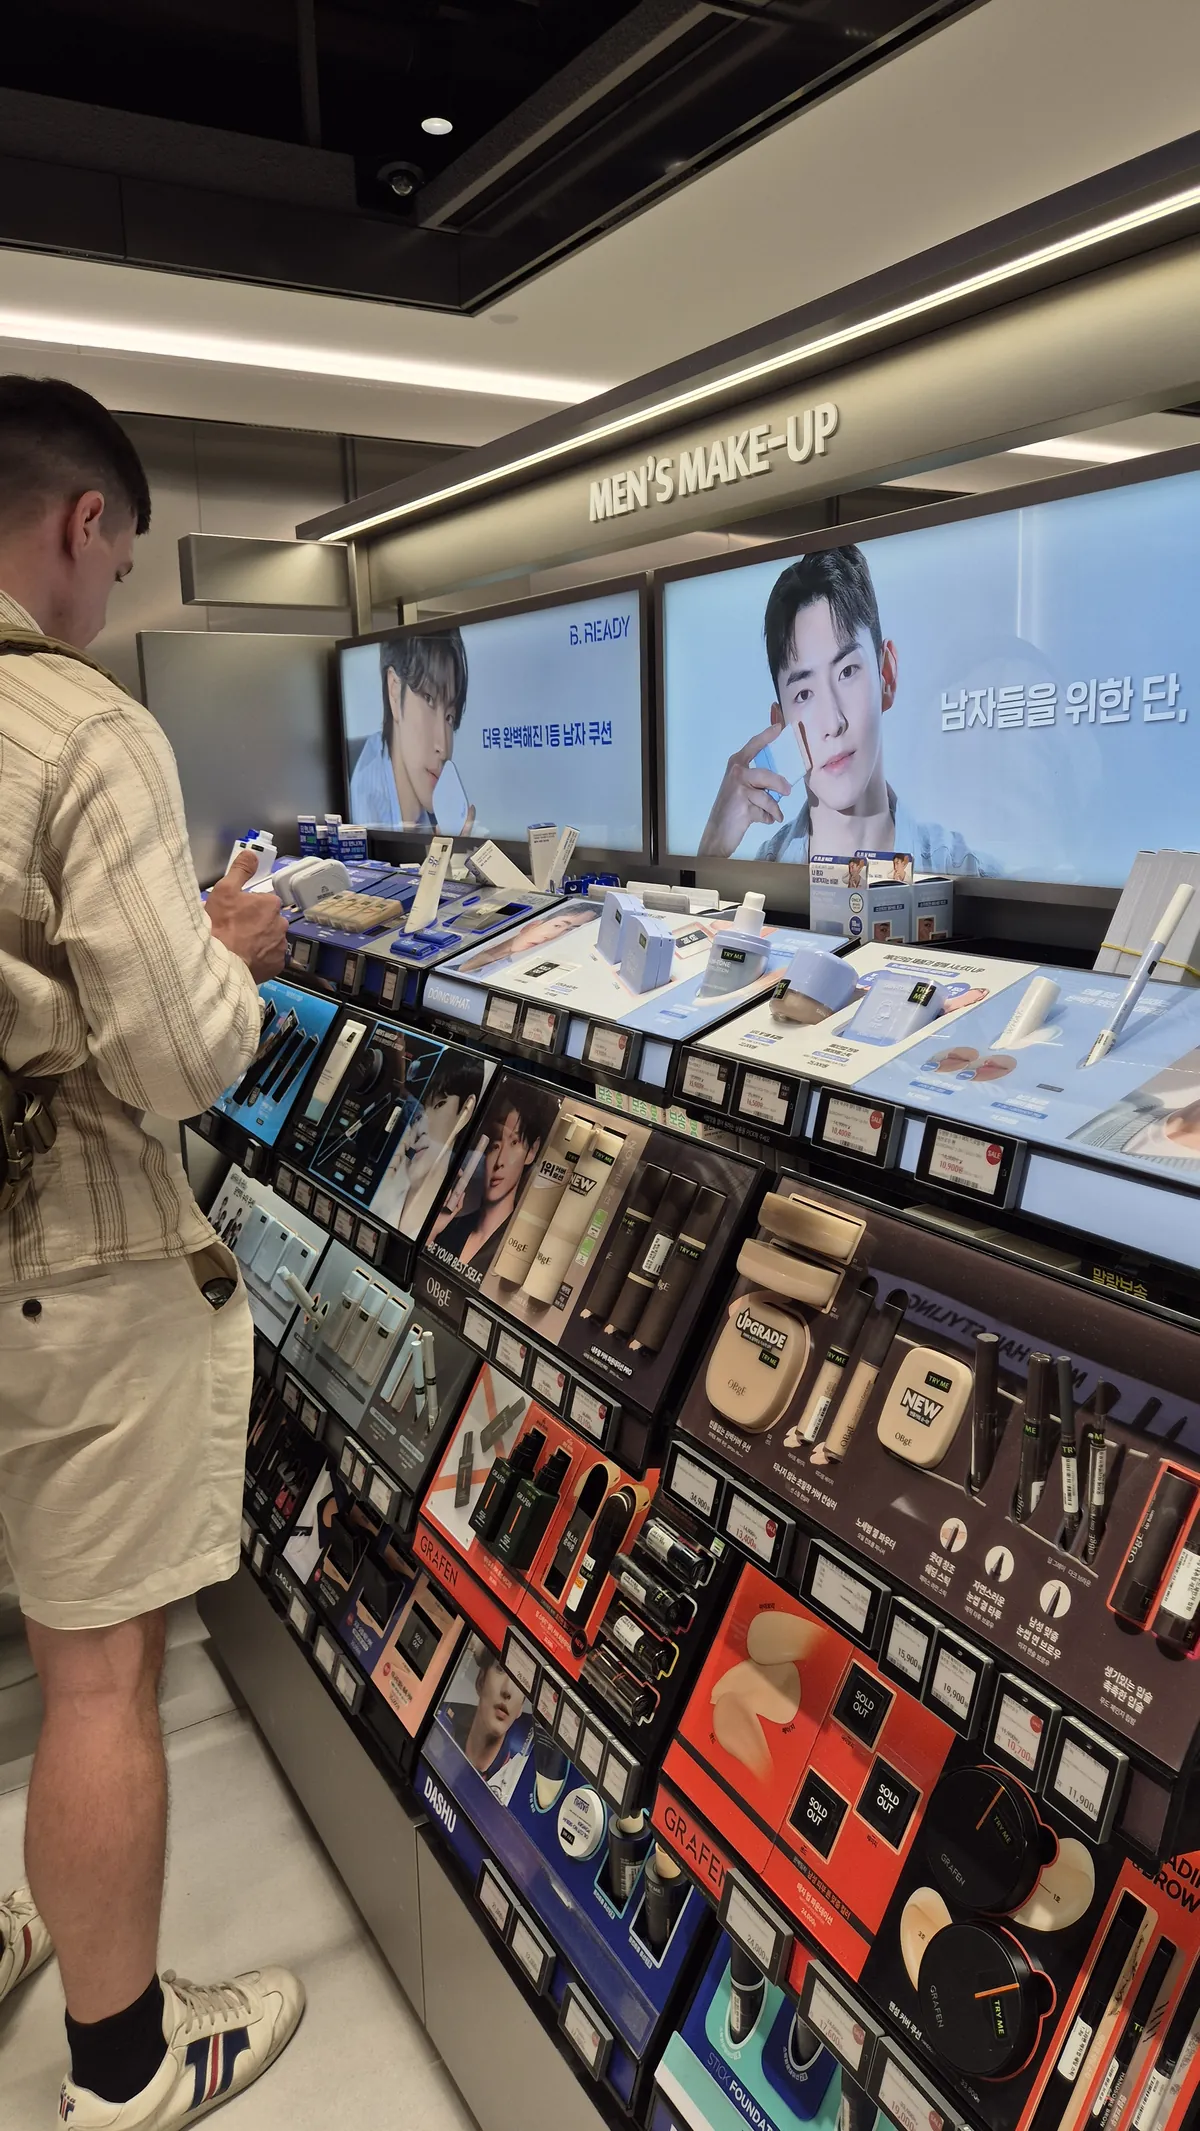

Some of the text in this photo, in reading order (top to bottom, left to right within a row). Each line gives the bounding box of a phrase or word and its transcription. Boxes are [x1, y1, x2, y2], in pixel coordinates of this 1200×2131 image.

[589, 402, 839, 522] MEN'S MAKE-UP
[570, 615, 630, 646] B. READY
[941, 672, 1188, 732] 남자들을 위한 단,
[483, 721, 612, 749] 더욱 완벽해진 1등 남자 쿠션
[871, 1116, 882, 1124] SALE
[987, 1150, 1001, 1160] SALE
[436, 1246, 454, 1266] YOUR
[451, 1256, 468, 1275] BEST
[537, 1252, 553, 1266] BgE
[426, 1277, 452, 1307] OBgE
[737, 1311, 787, 1349] UPGRADE
[928, 1376, 950, 1390] TRY ME
[903, 1389, 942, 1418] NEW
[1025, 1425, 1036, 1434] ME
[516, 1491, 532, 1508] GRAFEN
[878, 1532, 896, 1550] 파우더
[420, 1536, 459, 1587] GRAFEN
[942, 1560, 956, 1575] 창조
[936, 1573, 952, 1587] 스틱
[972, 1580, 1005, 1608] 자연스러운
[966, 1591, 981, 1608] 눈썹
[987, 1604, 1002, 1621] 타투
[1016, 1624, 1032, 1642] 눈썹
[1039, 1639, 1061, 1660] 브로우
[1028, 1616, 1059, 1643] 남성 맞춤
[896, 1648, 922, 1671] 15,900원
[943, 1682, 970, 1710] 19,900원
[1102, 1680, 1145, 1714] 촉촉한 입술
[1104, 1665, 1153, 1705] 생기있는 입술
[852, 1702, 868, 1719] OUT
[855, 1690, 875, 1711] SOLD
[423, 1776, 457, 1833] DASHU
[808, 1797, 828, 1819] SOLD
[876, 1796, 894, 1814] OUT
[878, 1784, 900, 1806] SOLD
[1067, 1785, 1100, 1817] 11,900원
[806, 1808, 823, 1826] OUT
[993, 1815, 1012, 1844] TRY ME
[940, 1853, 966, 1887] GRAFEN
[1143, 1870, 1200, 1913] ROW
[930, 1985, 944, 2028] GRAFEN
[994, 1999, 1005, 2035] TRY ME
[899, 2012, 911, 2029] 커버
[910, 2024, 922, 2040] 쿠션
[1134, 2022, 1144, 2033] TR
[707, 2052, 730, 2086] STICK
